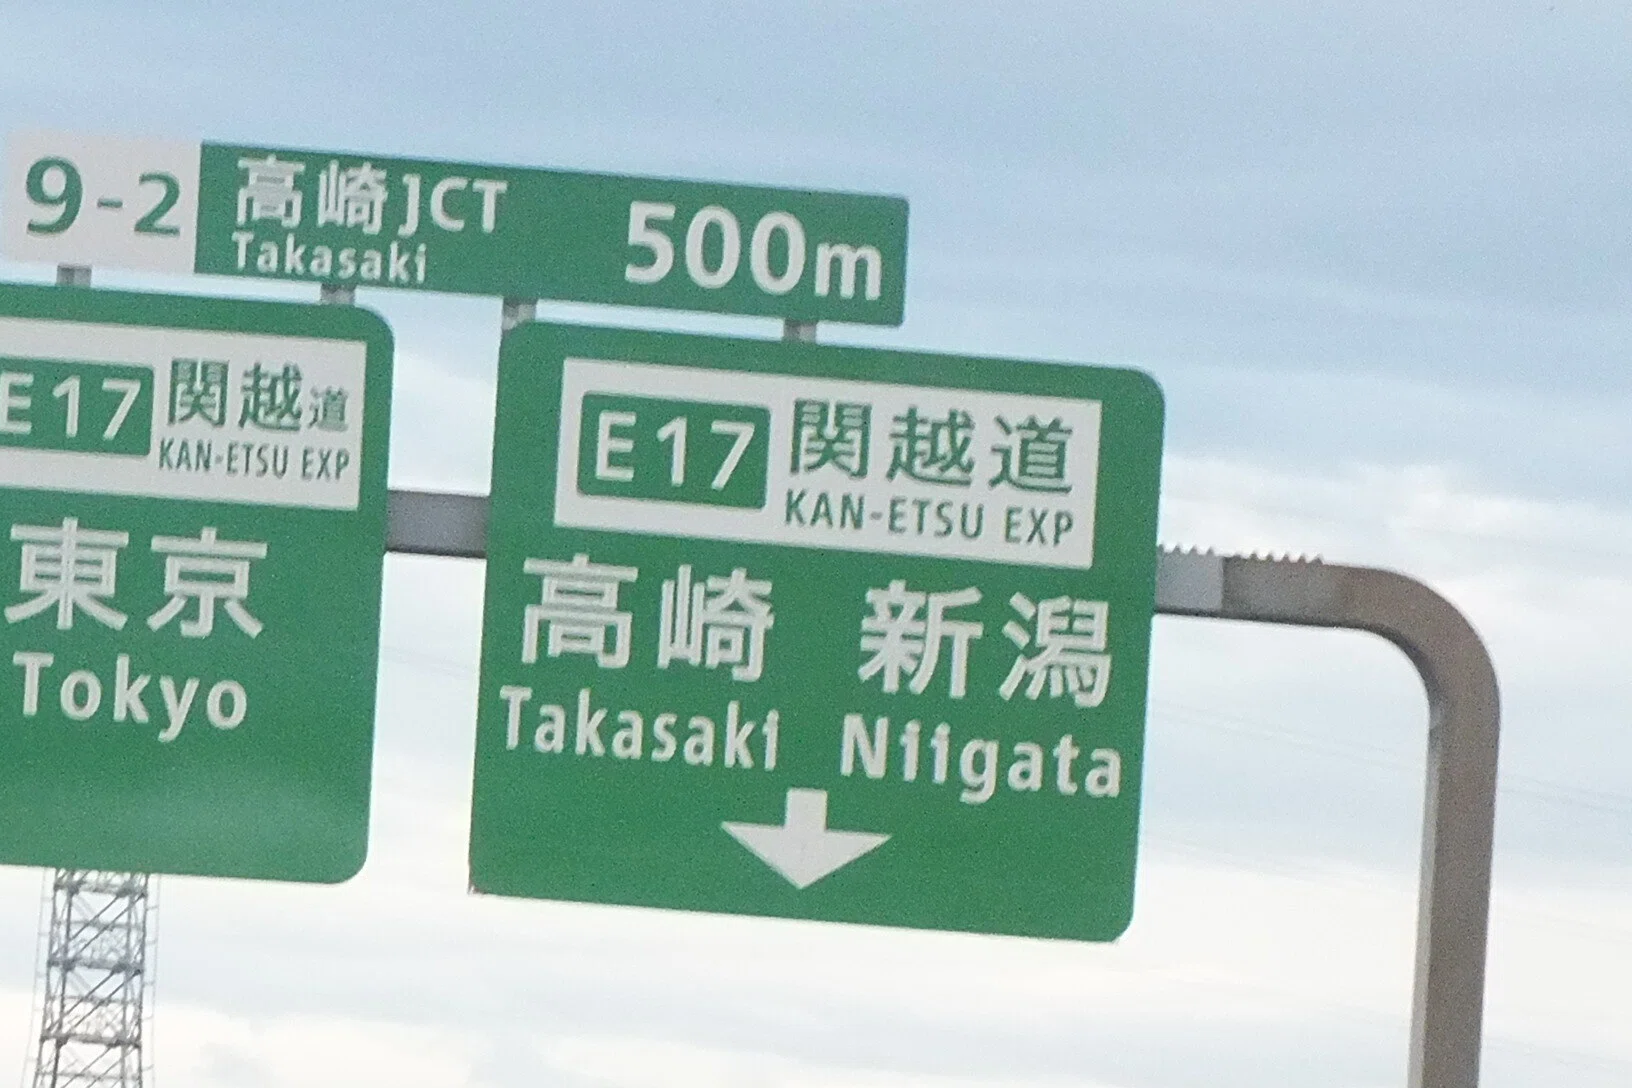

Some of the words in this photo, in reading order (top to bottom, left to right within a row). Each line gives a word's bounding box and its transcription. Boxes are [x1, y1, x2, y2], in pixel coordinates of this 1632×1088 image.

[24, 155, 182, 238] 9-2
[235, 153, 509, 236] 高崎JCT
[622, 199, 884, 301] 500m
[229, 229, 428, 285] Takasaki
[166, 356, 349, 434] 関越道
[158, 437, 289, 479] KAN-ETSU
[301, 446, 351, 481] EXP
[594, 409, 756, 490] E17
[788, 398, 1074, 496] 関越道
[783, 488, 985, 541] KAN-ETSU
[1003, 505, 1075, 547] EXP
[3, 516, 269, 639] 東京
[520, 553, 776, 683] 高崎
[857, 579, 1113, 709] 新潟
[11, 650, 249, 743] Tokyo
[498, 685, 781, 772] Takasaki
[839, 712, 1123, 806] Niigata
